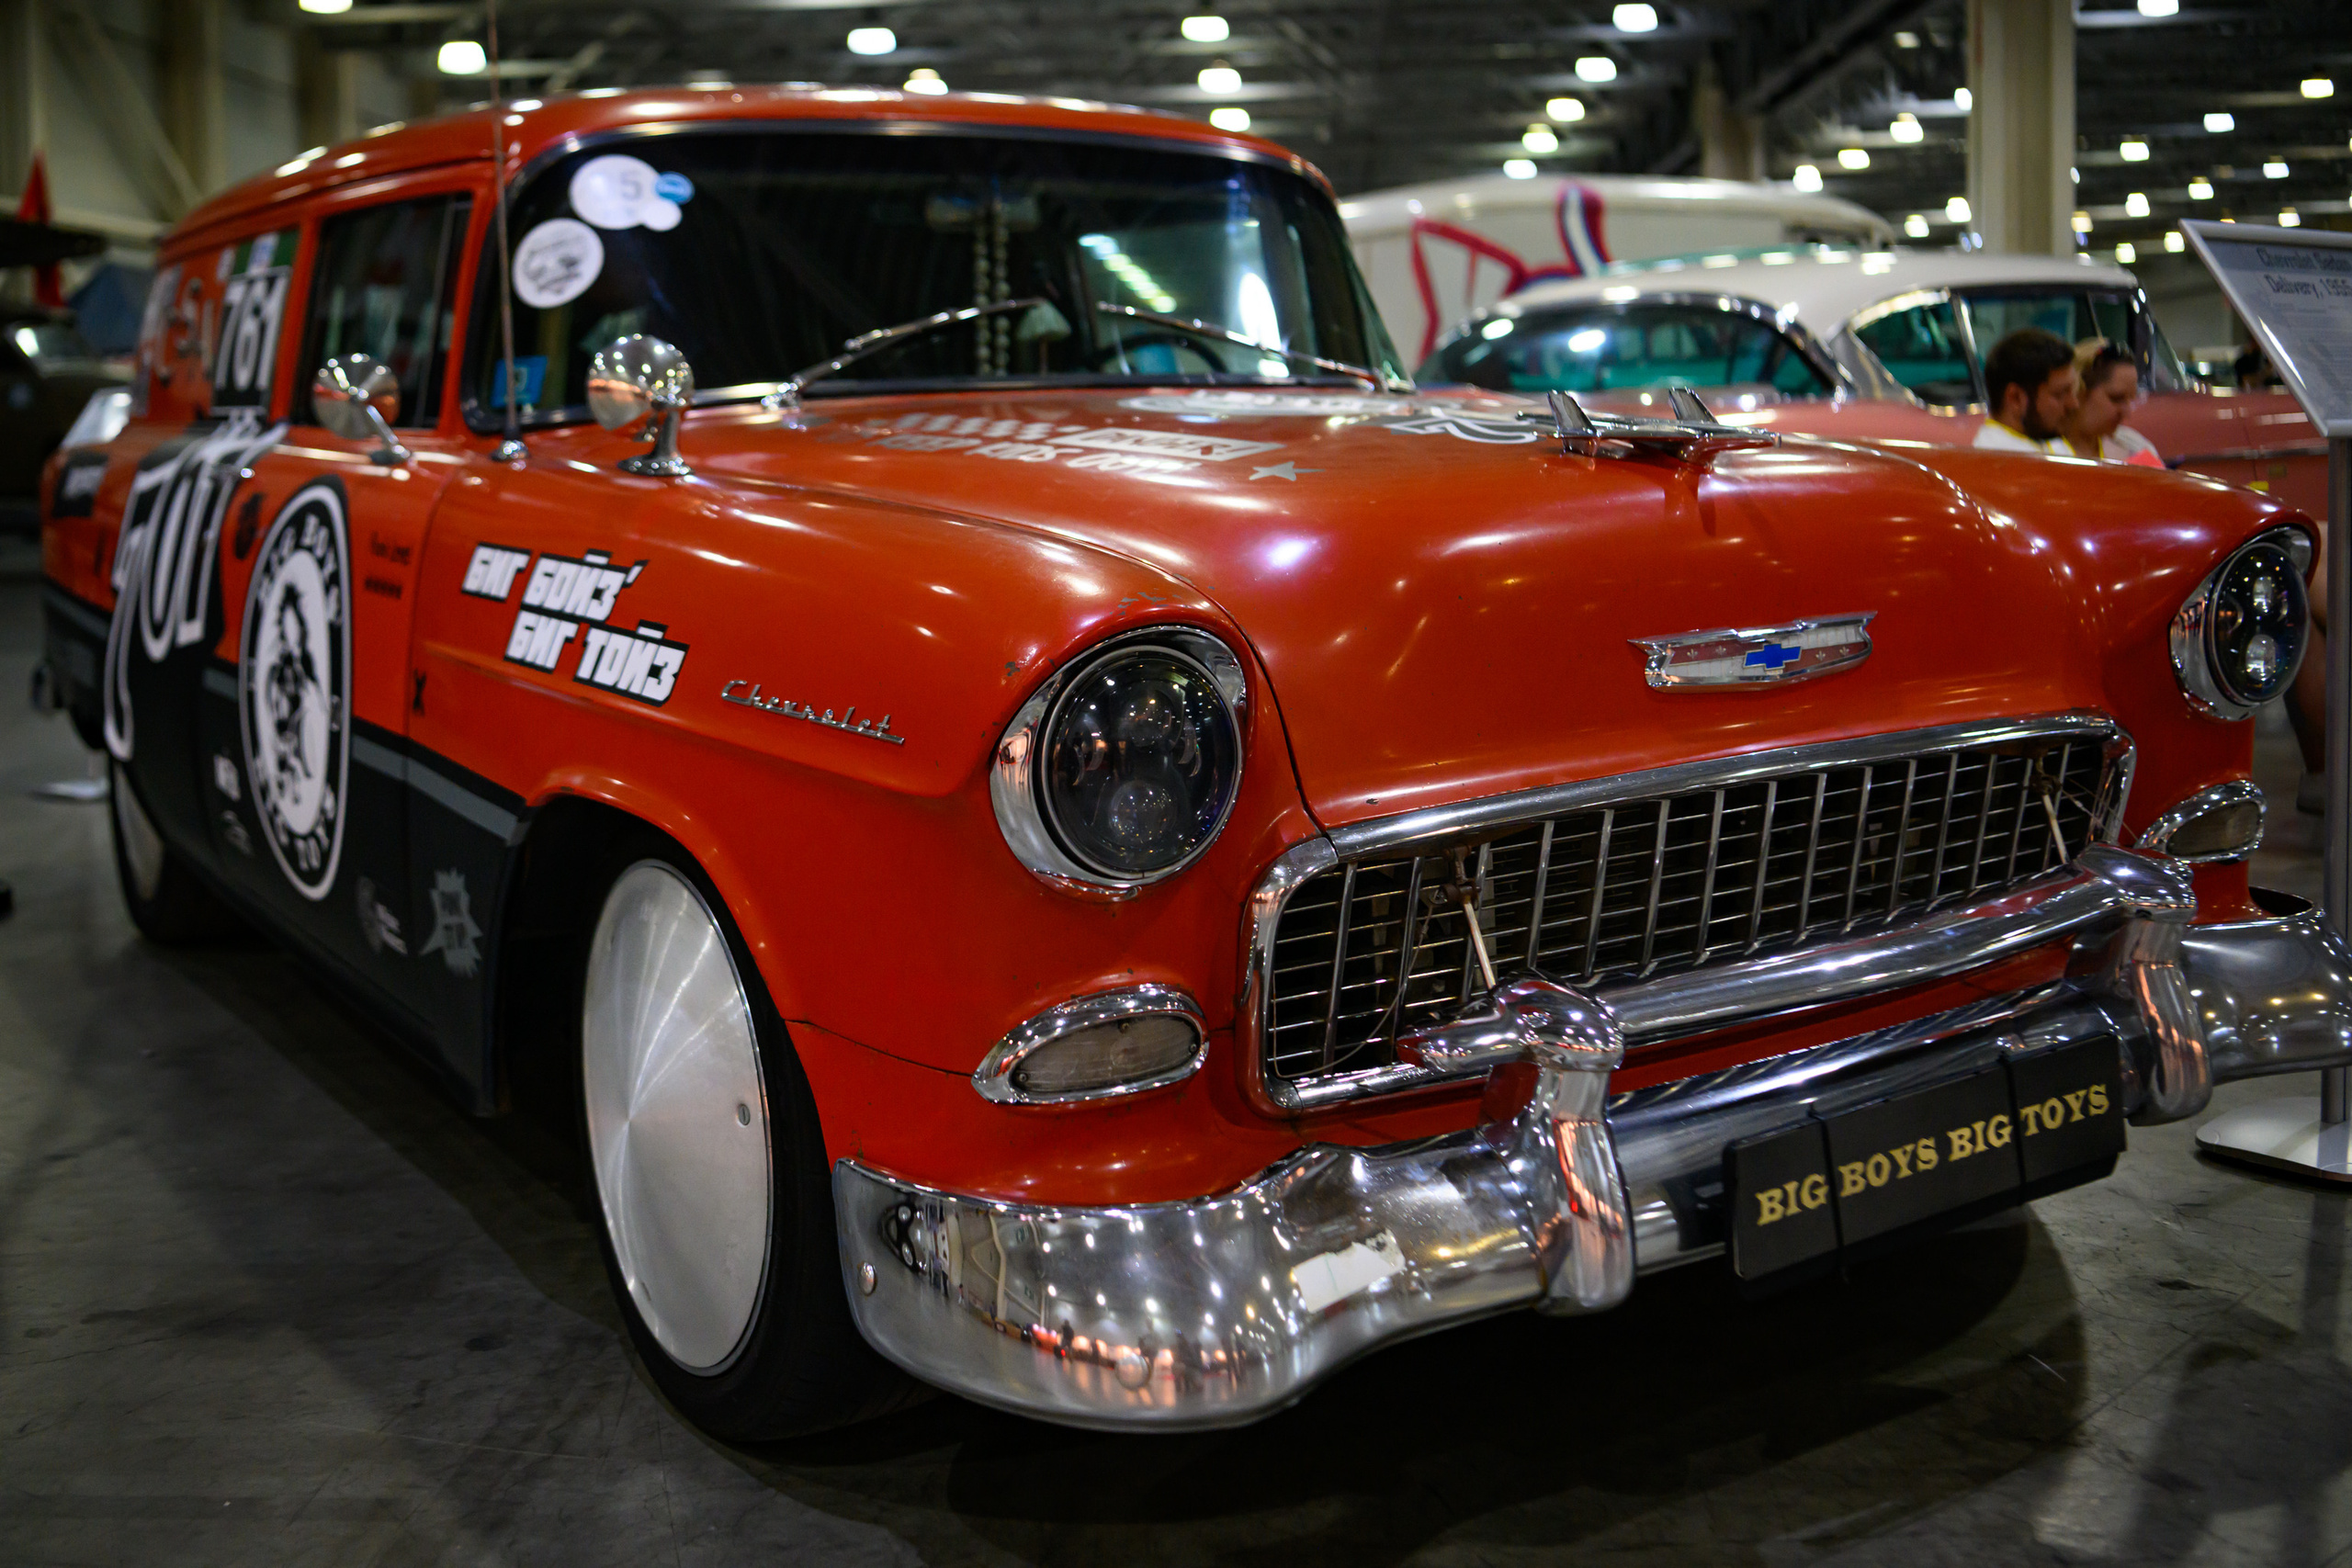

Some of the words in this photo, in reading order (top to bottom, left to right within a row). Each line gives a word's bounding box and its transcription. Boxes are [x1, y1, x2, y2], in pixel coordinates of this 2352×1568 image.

[721, 680, 905, 745] Chevrolet
[1756, 1173, 1829, 1226] BIG
[1838, 1136, 1939, 1197] BOYS
[1947, 1114, 2014, 1162] BIG
[2019, 1084, 2110, 1137] TOYS
